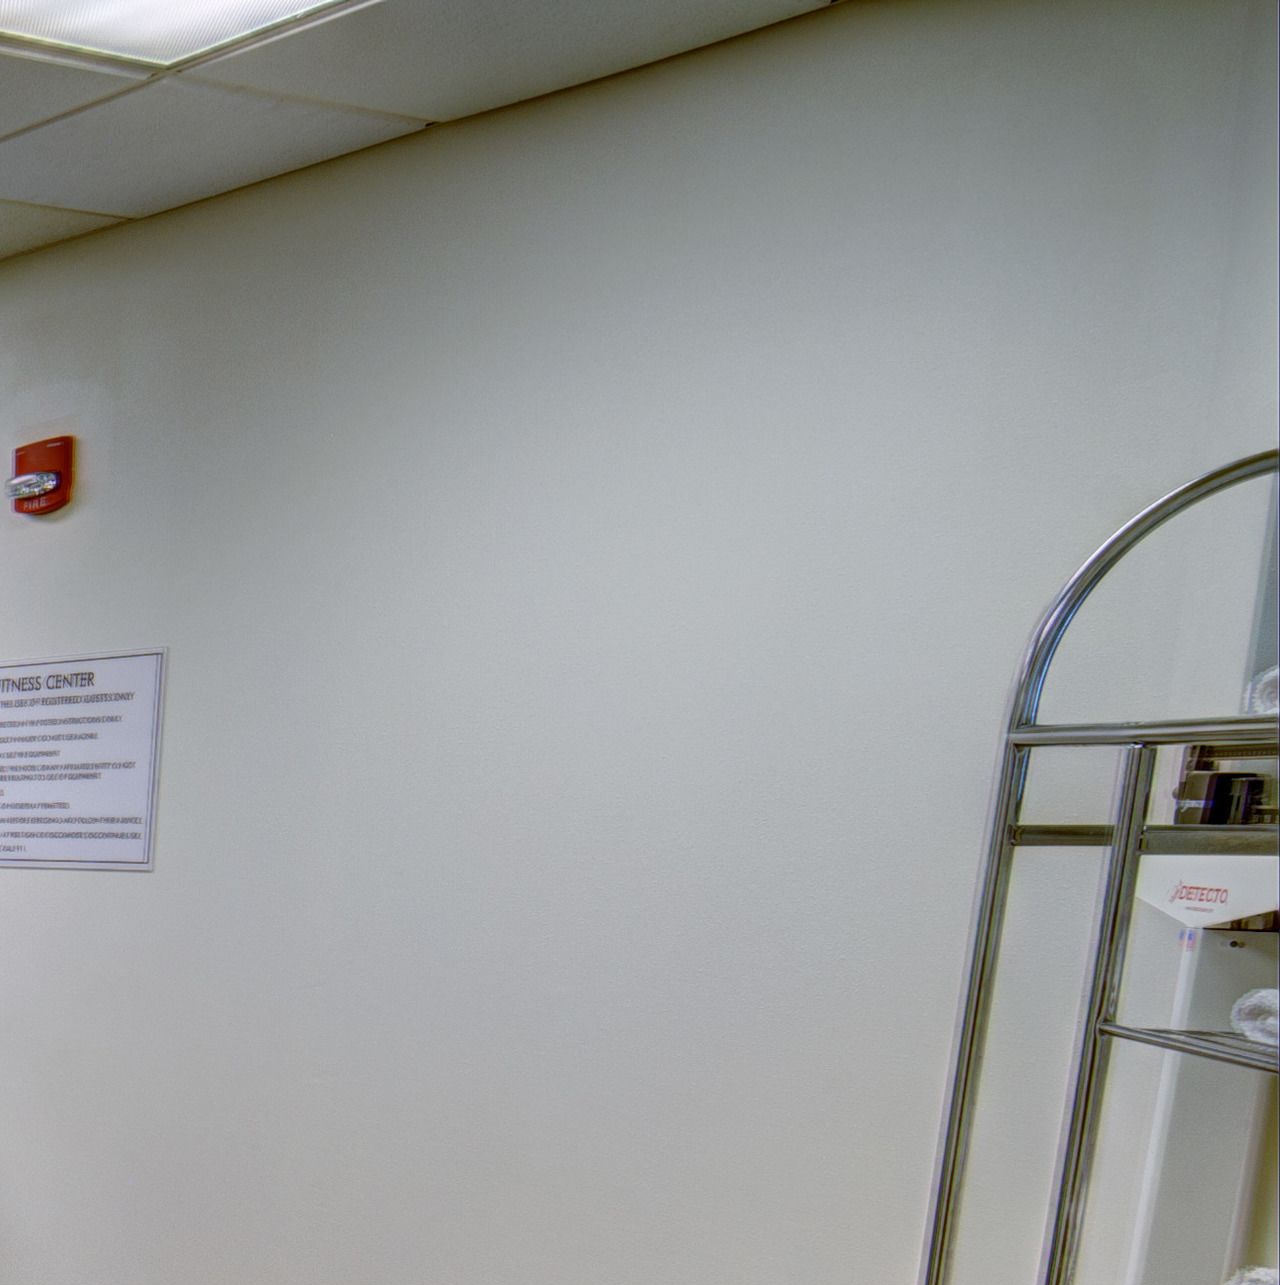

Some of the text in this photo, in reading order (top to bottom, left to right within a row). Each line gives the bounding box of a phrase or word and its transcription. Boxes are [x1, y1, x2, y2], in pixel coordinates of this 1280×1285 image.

[23, 497, 48, 511] FIRE
[44, 672, 95, 690] CENTER
[1177, 885, 1228, 904] DETECTO
